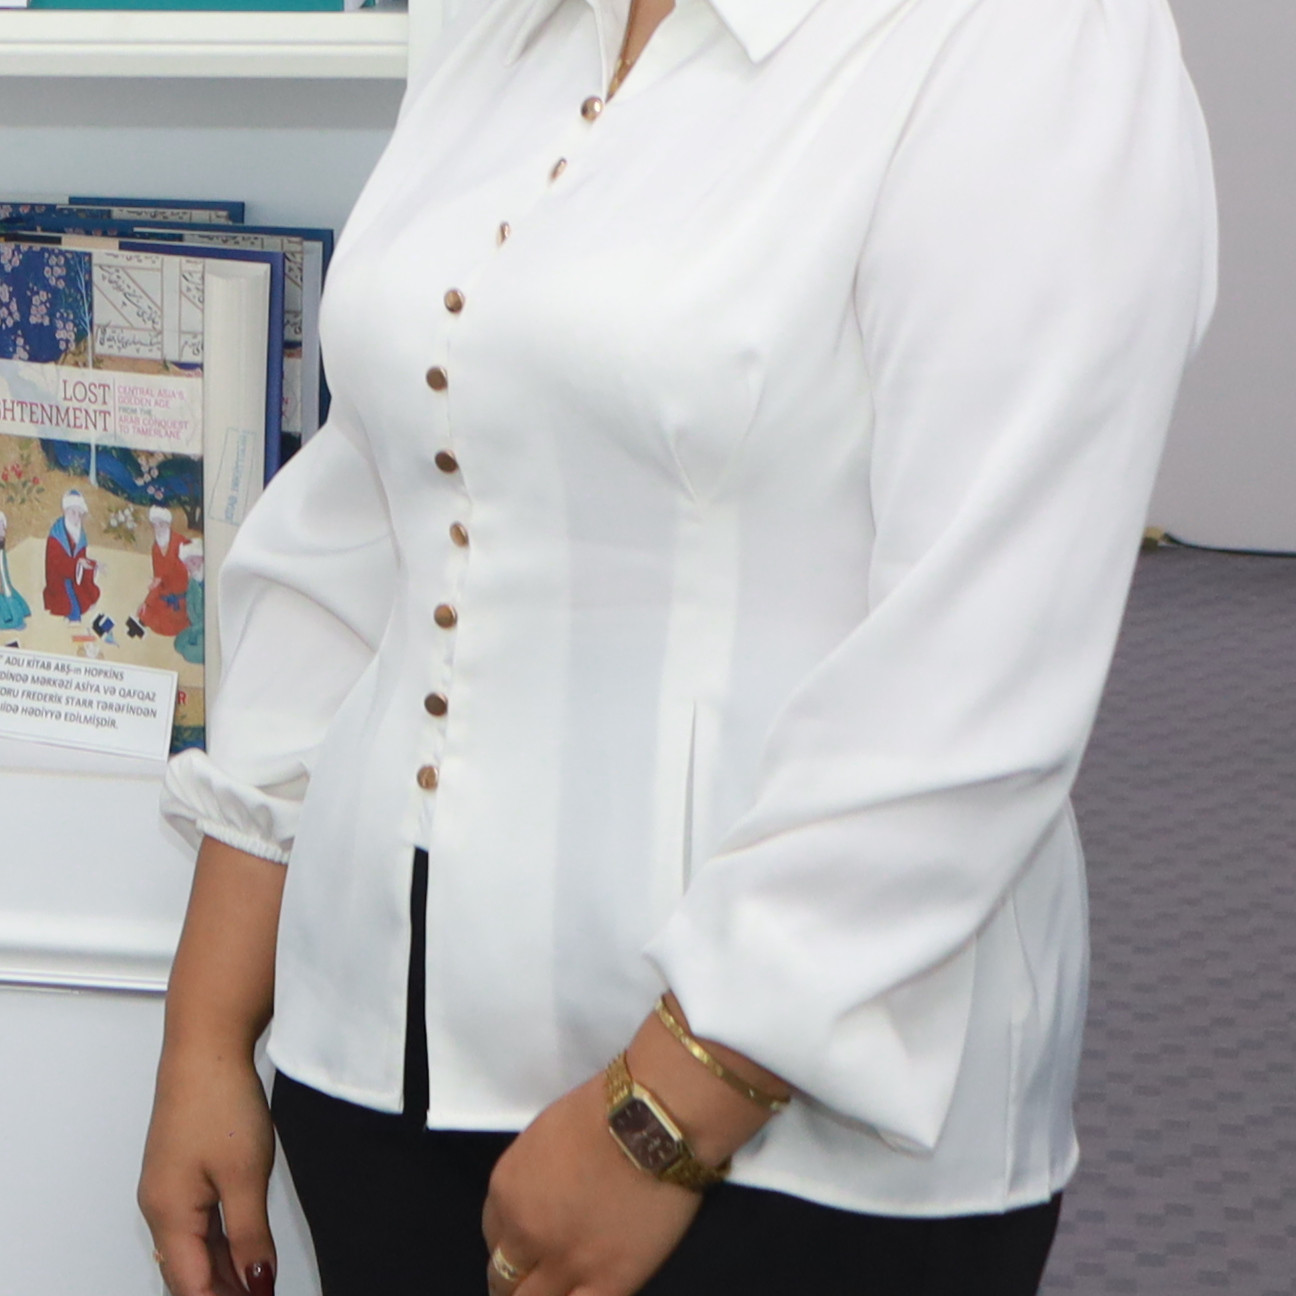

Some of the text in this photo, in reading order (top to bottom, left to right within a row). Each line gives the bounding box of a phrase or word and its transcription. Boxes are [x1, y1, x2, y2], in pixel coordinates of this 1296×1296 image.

[62, 379, 112, 406] LOST
[118, 396, 171, 409] GOLDEN AGE
[65, 695, 94, 709] STARR
